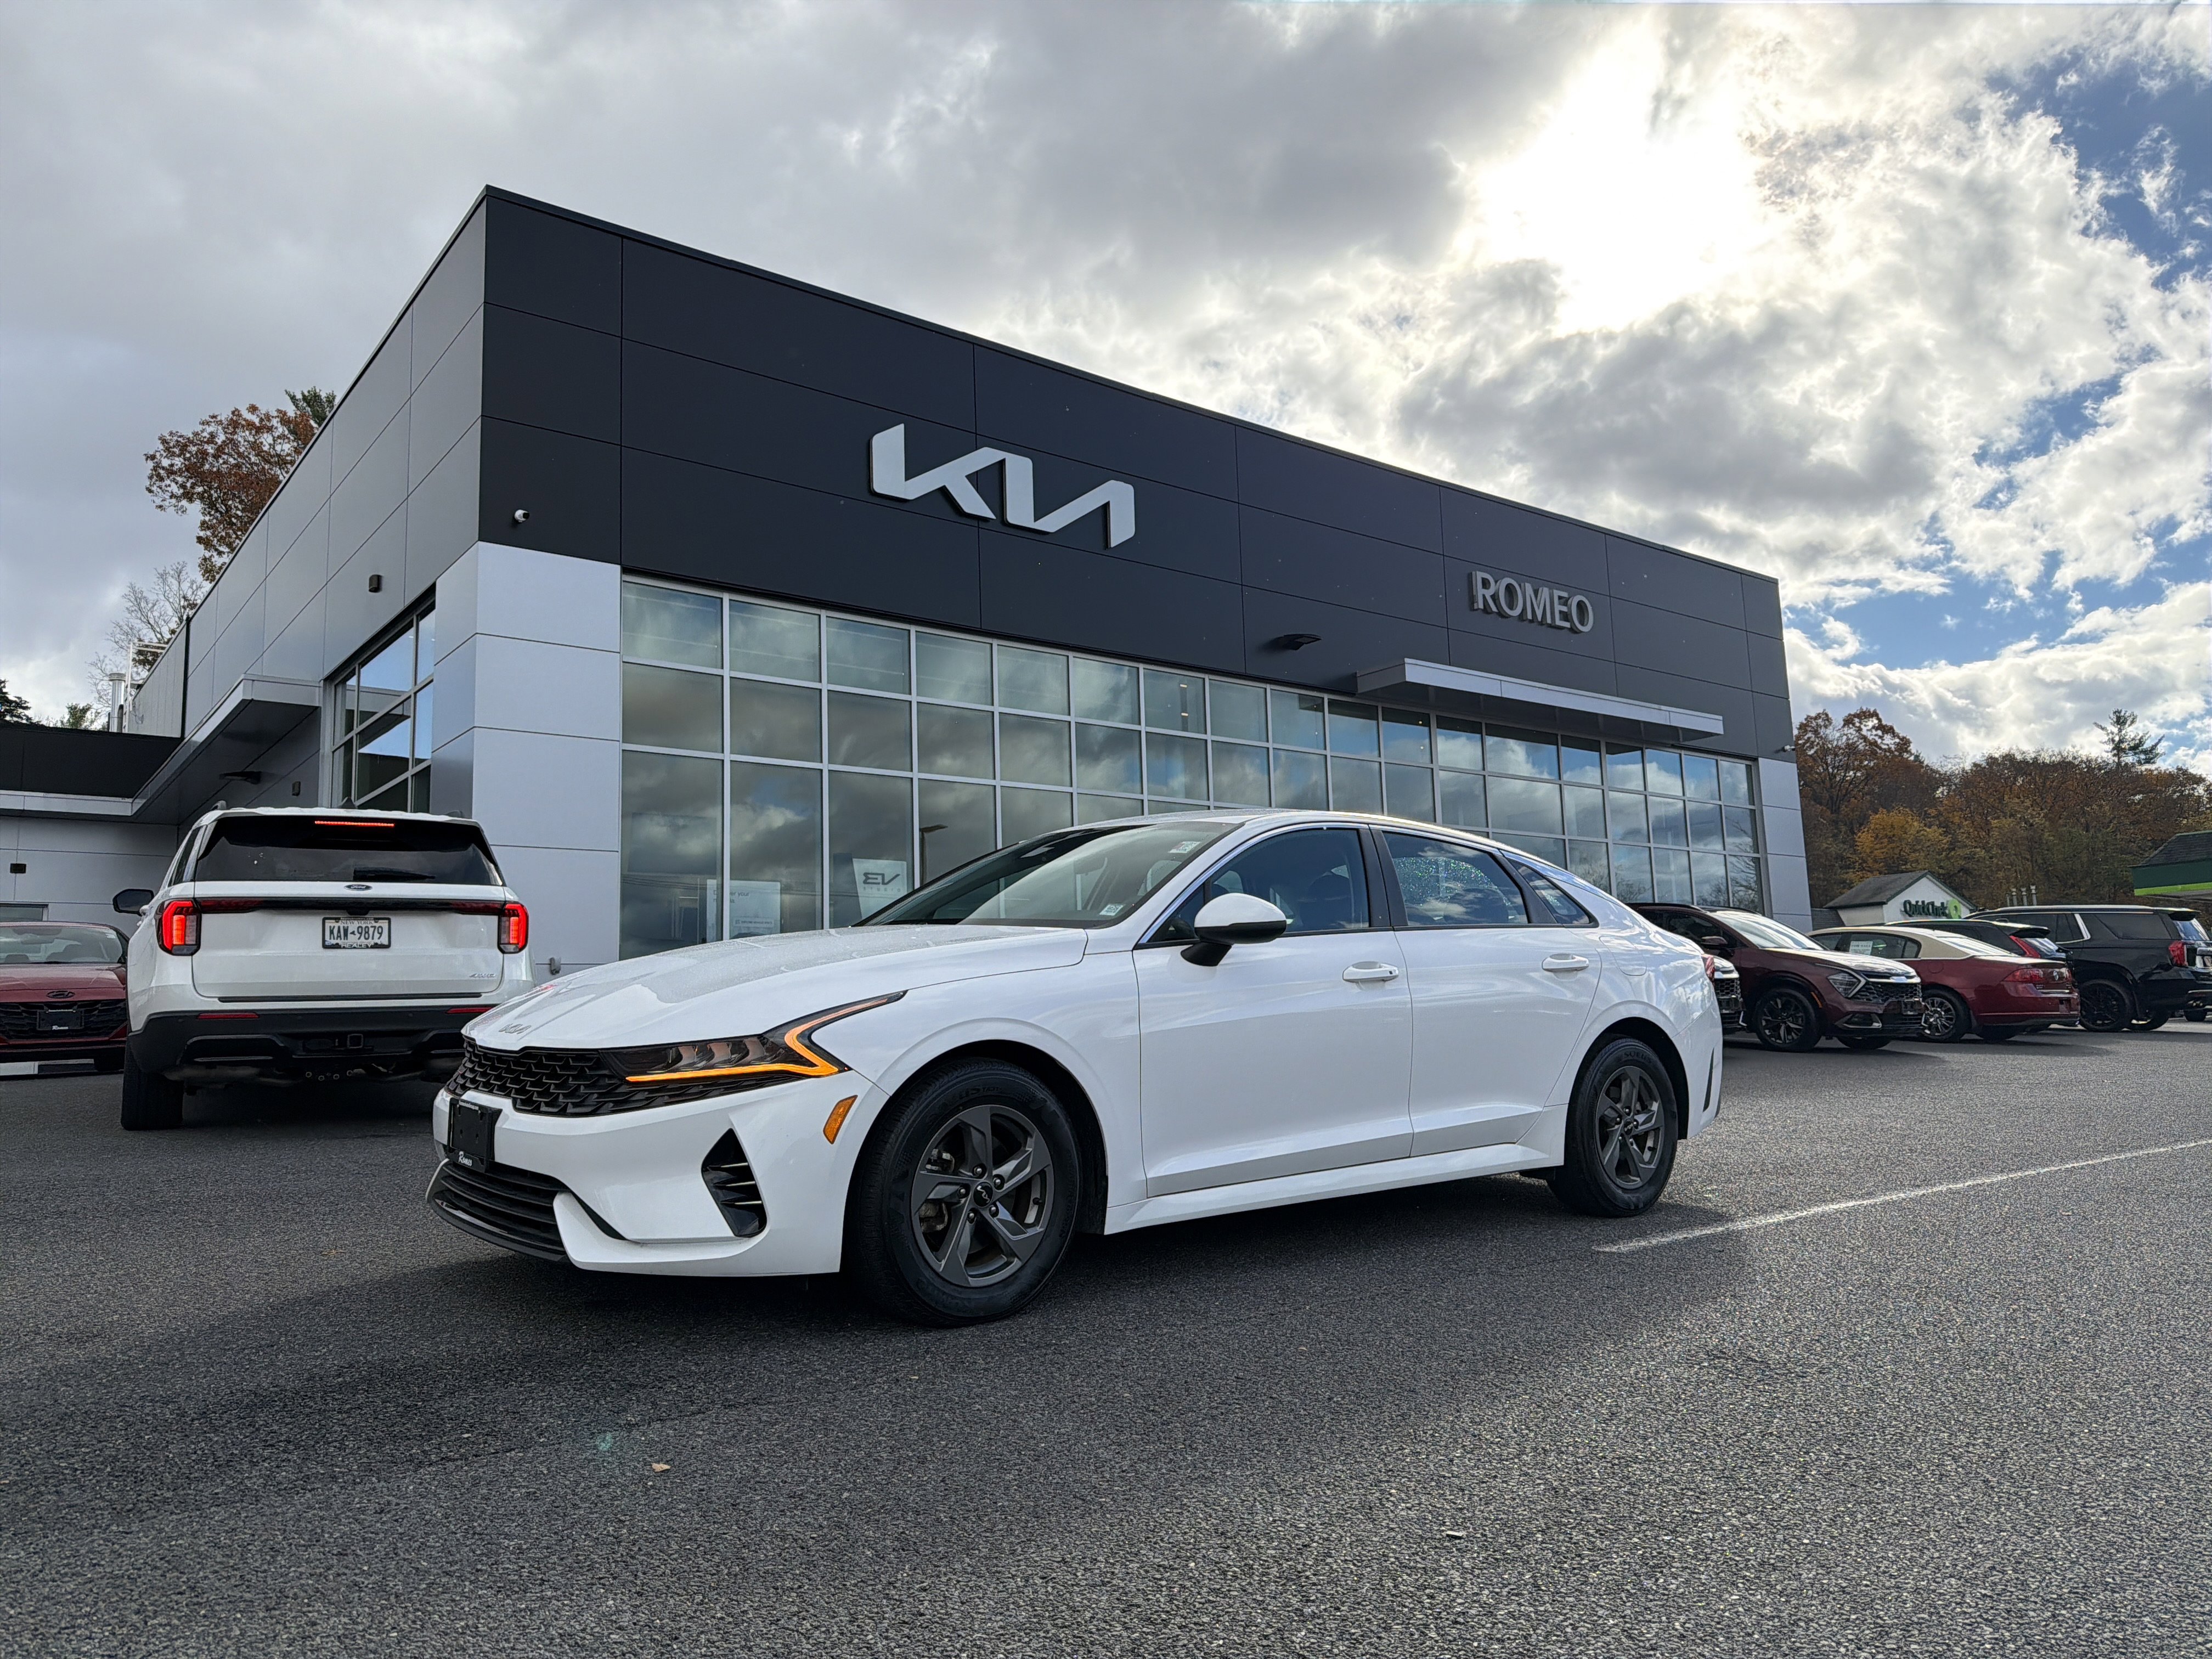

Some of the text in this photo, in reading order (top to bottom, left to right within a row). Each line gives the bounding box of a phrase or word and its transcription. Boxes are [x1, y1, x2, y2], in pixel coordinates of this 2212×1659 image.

[870, 423, 1136, 548] KIA
[1472, 571, 1594, 633] ROMEO
[863, 872, 901, 885] EV
[329, 926, 383, 940] KAW 9879
